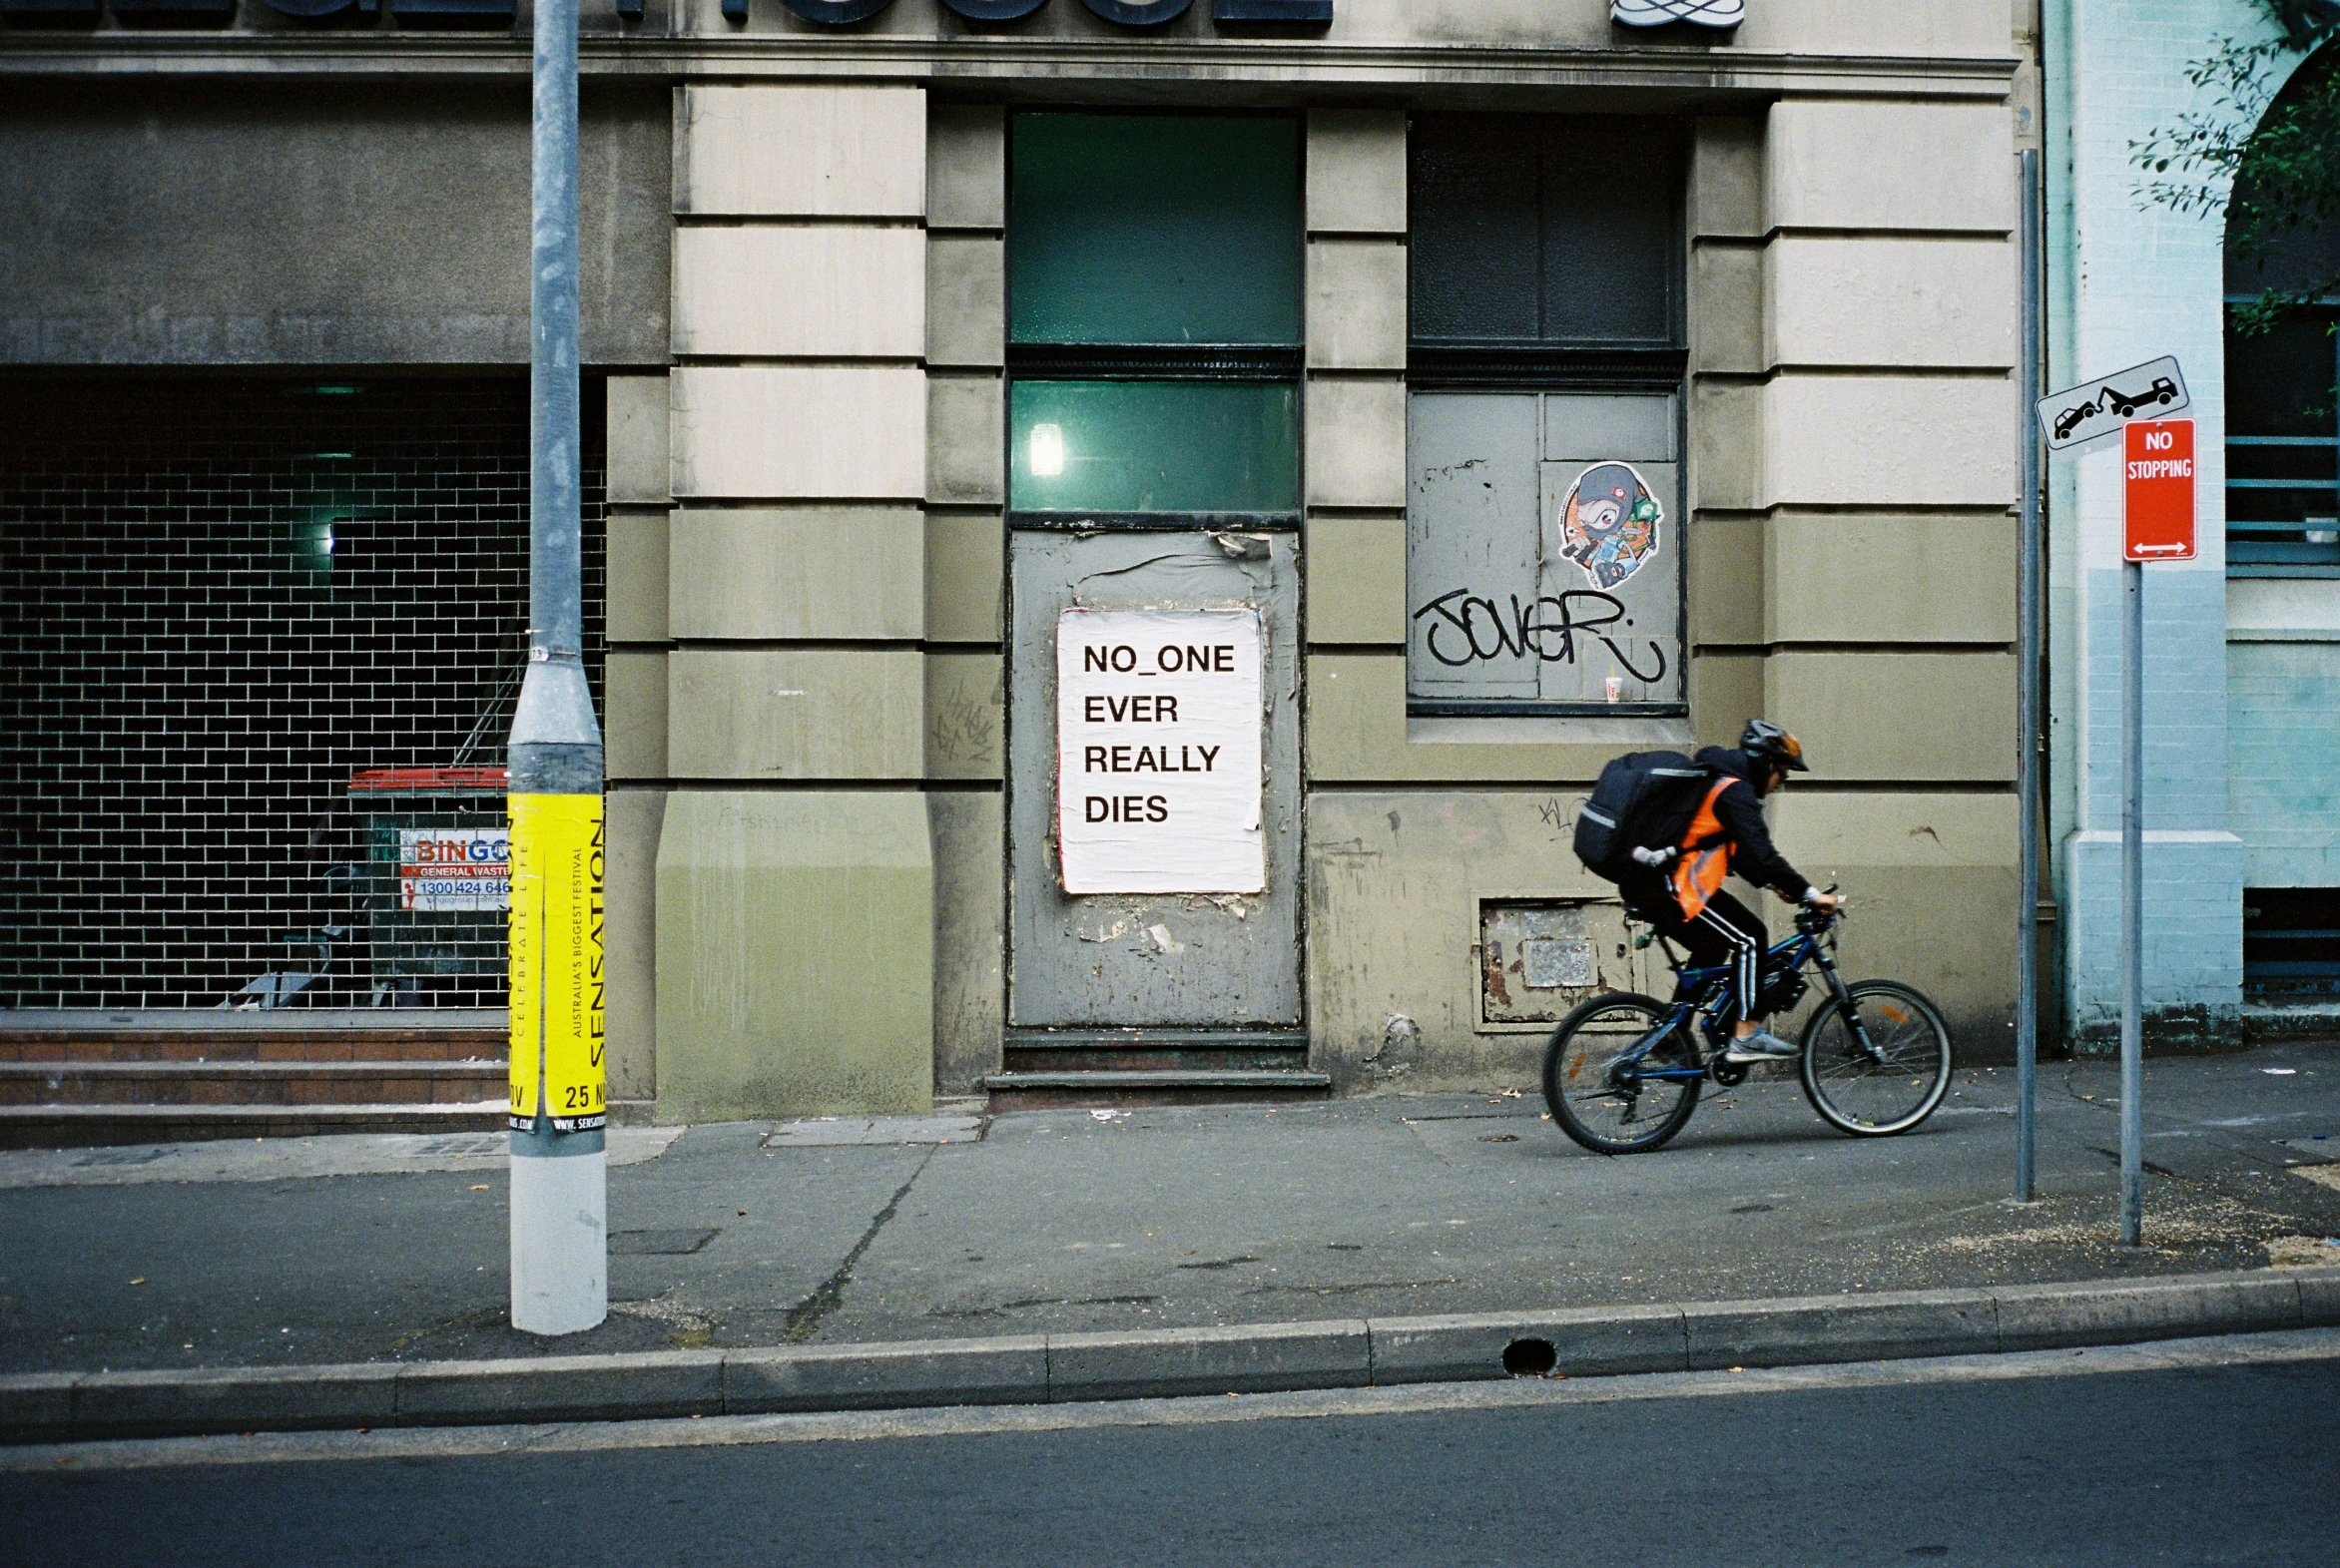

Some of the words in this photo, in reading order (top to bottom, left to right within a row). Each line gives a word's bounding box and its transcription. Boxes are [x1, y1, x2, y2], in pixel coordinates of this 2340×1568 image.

[2146, 432, 2173, 450] NO
[2128, 459, 2191, 479] STOPPING
[1084, 696, 1178, 723] EVER
[1084, 746, 1221, 773] REALLY
[1084, 795, 1168, 823] DIES
[420, 867, 470, 876] GENERAL
[472, 866, 509, 876] WASTE
[572, 848, 582, 900] FESTIVAL
[421, 882, 452, 894] 1300
[456, 882, 481, 894] 424
[485, 882, 510, 894] 646
[572, 907, 582, 956] BIGGEST
[572, 961, 582, 1038] AUSTRALIA'S
[566, 1085, 589, 1108] 25
